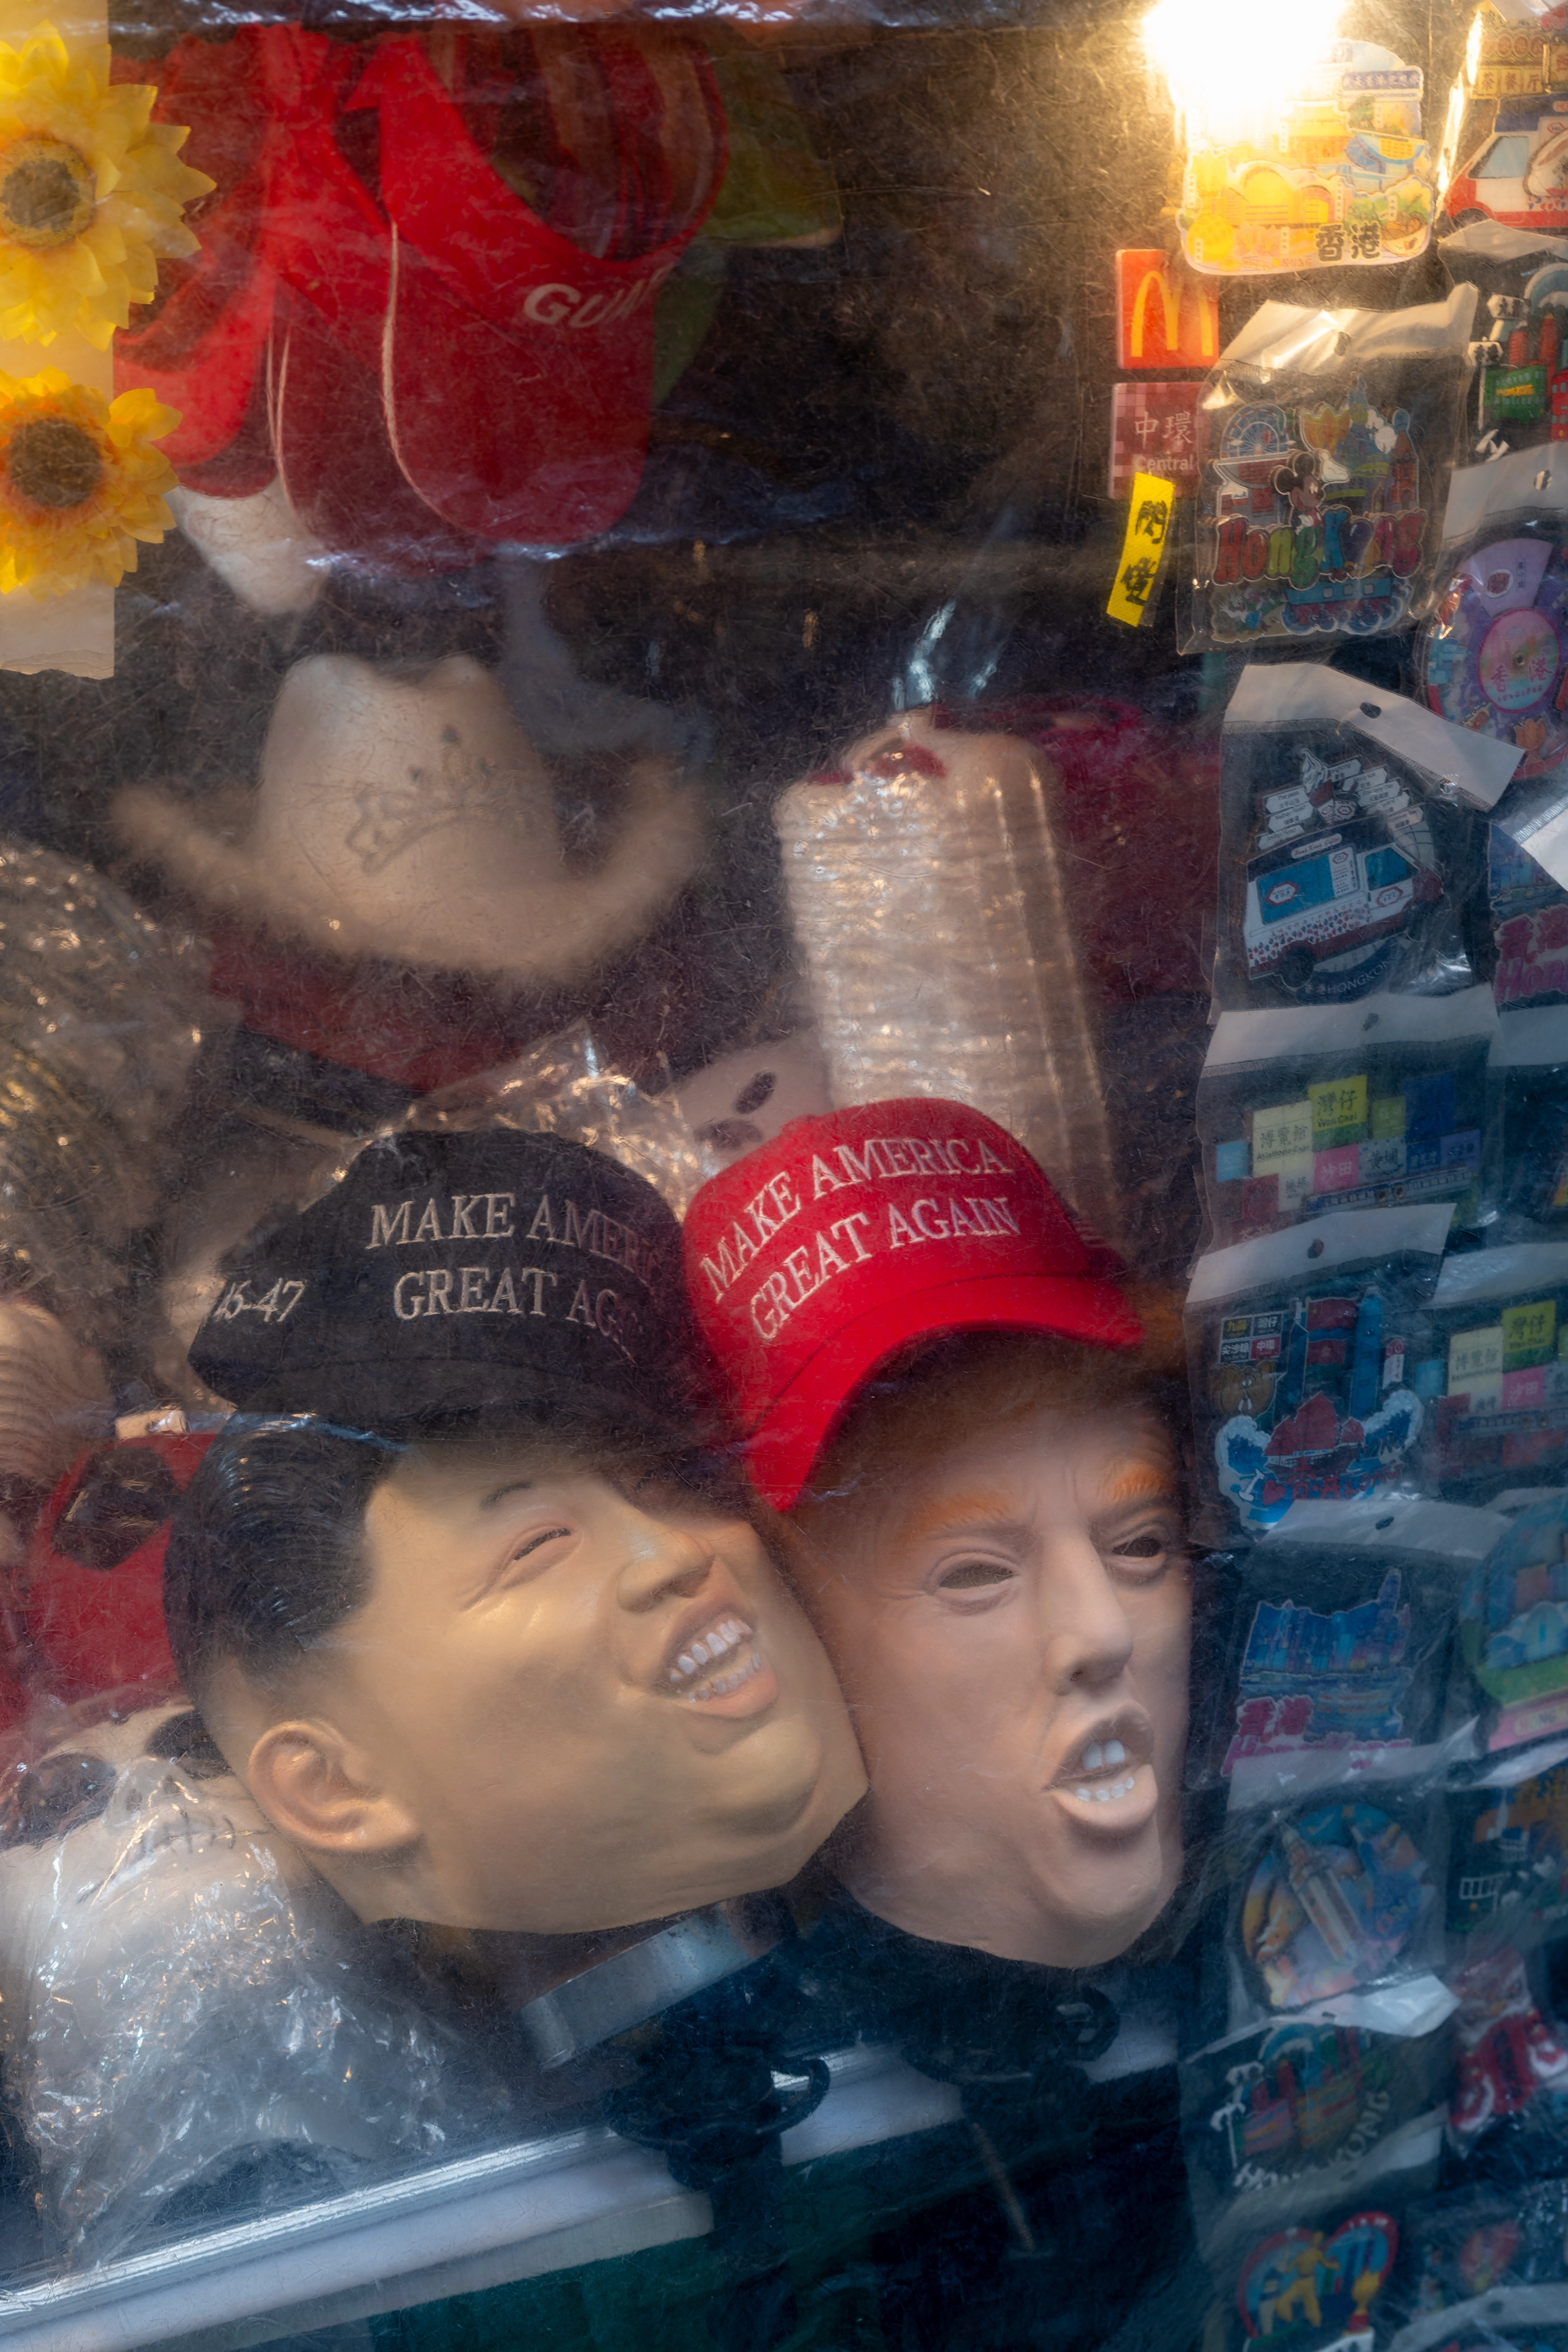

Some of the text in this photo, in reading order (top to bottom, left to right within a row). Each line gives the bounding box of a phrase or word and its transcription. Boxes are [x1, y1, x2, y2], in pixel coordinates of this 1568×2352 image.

[1315, 222, 1380, 262] 香港
[1134, 410, 1194, 450] 中環
[1134, 454, 1195, 471] Central
[1490, 653, 1553, 693] 香港
[1495, 960, 1568, 1004] Hon
[1316, 1090, 1358, 1117] 灣仔
[1259, 1124, 1309, 1149] 博覽館
[365, 1192, 516, 1249] MAKE
[700, 1137, 1015, 1302] MAKE AMERICA
[750, 1195, 1022, 1342] GREAT AGAIN
[394, 1266, 557, 1321] GREAT
